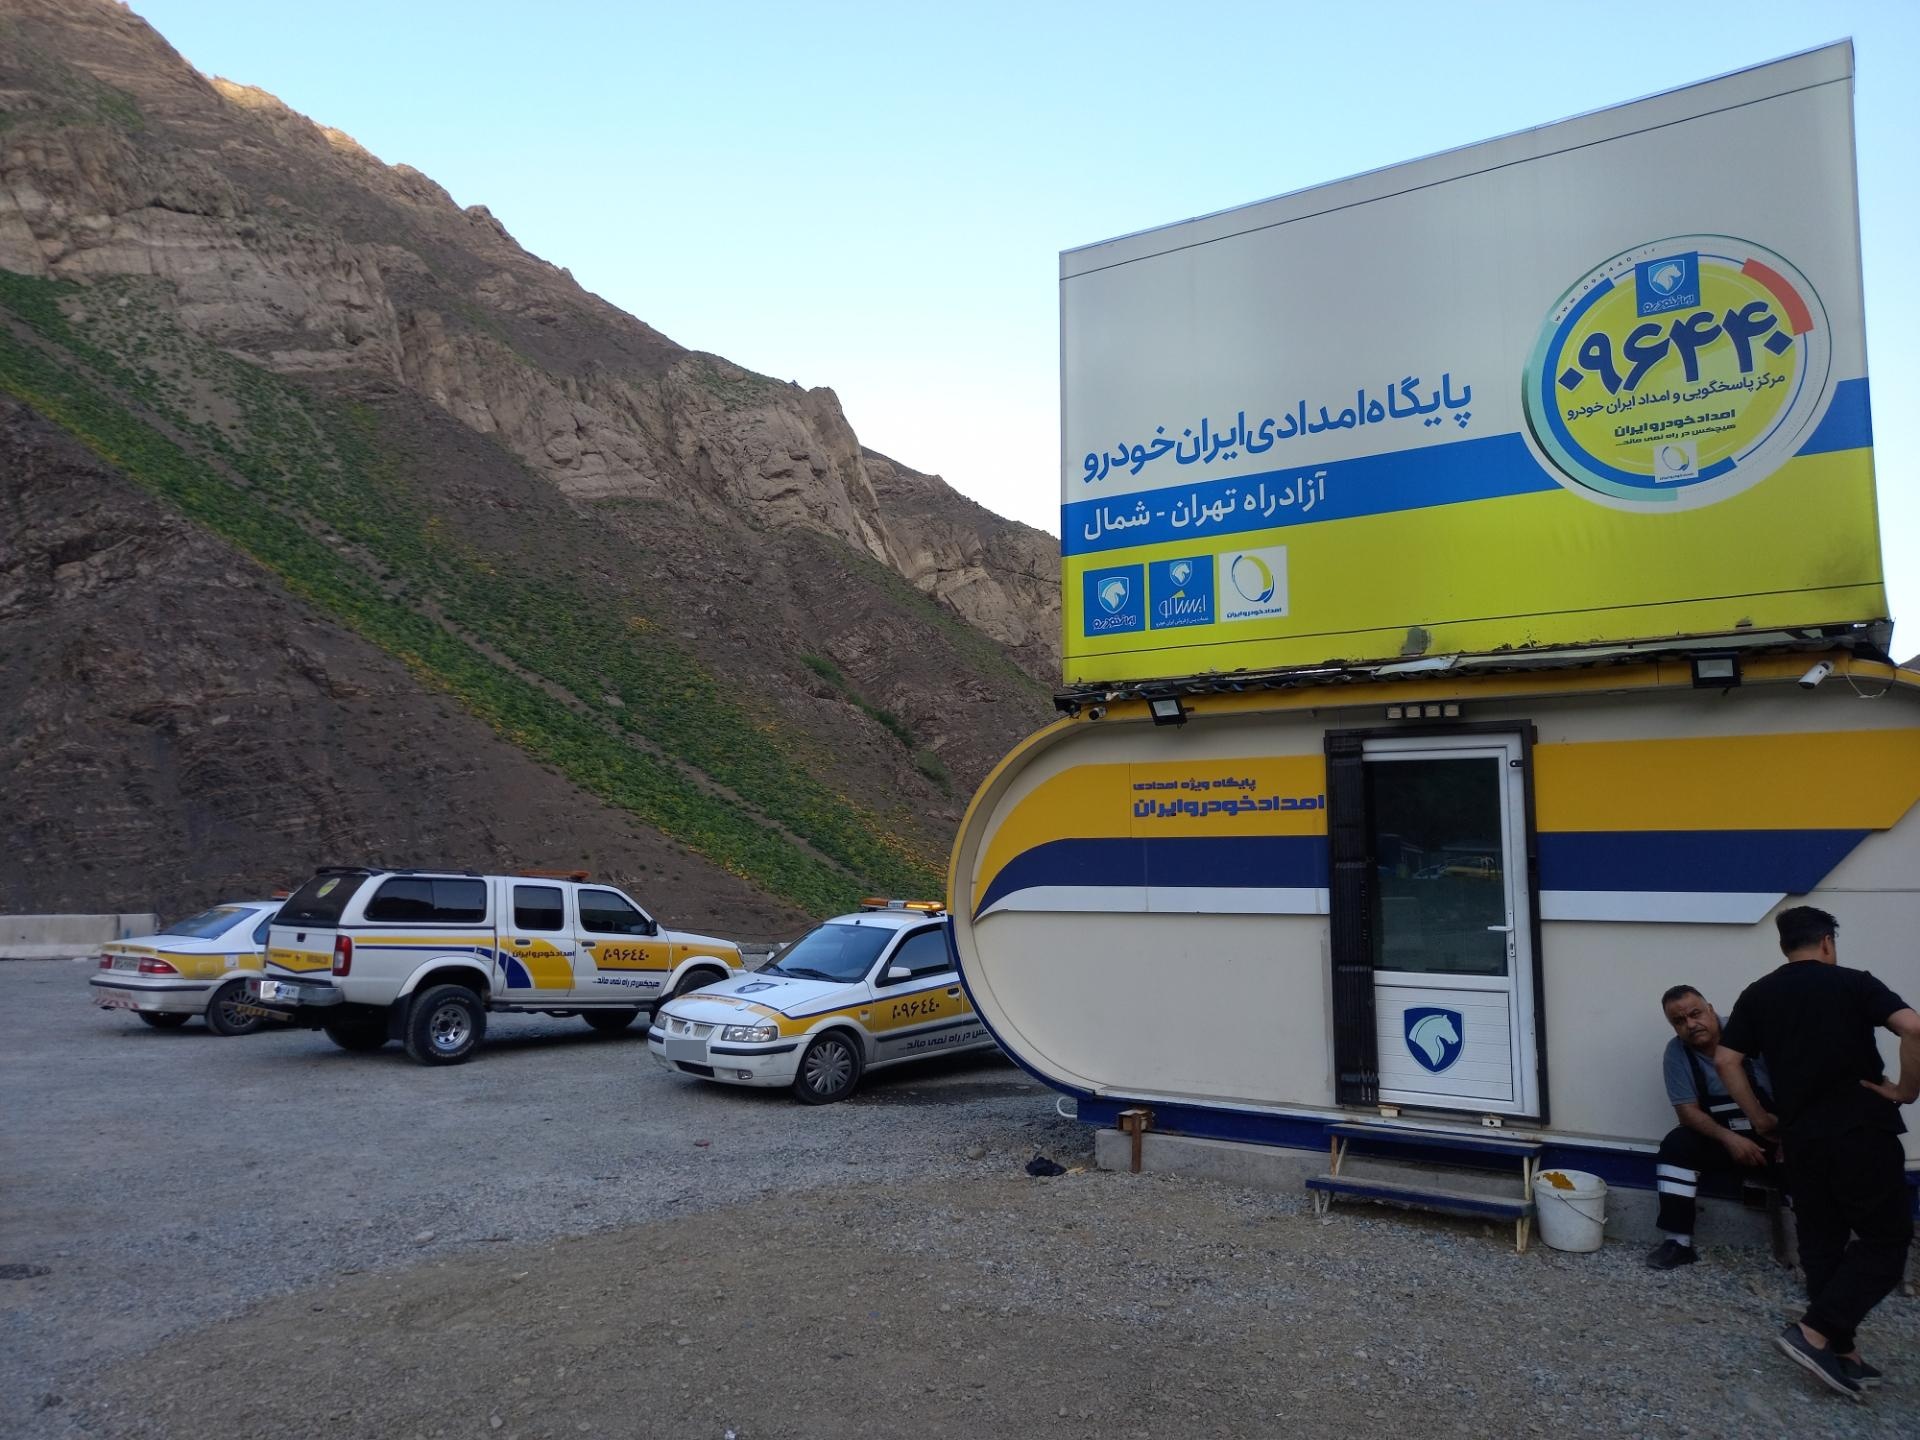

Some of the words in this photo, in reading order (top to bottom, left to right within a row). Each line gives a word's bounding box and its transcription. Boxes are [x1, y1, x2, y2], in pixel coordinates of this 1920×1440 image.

[1558, 301, 1793, 395] ۰۹۶۴۴۰
[1683, 376, 1753, 401] پاسخگویی
[1756, 372, 1785, 391] مرکز
[1367, 373, 1471, 428] پایگاه
[1606, 396, 1636, 414] ایران
[1639, 390, 1670, 406] امداد
[1673, 393, 1680, 403] و
[1567, 401, 1604, 420] خودرو
[1247, 389, 1368, 454] امدادی
[1176, 412, 1246, 465] ایران
[1665, 431, 1679, 439] راه
[1680, 430, 1690, 438] در
[1084, 426, 1175, 483] خودرو
[1171, 489, 1236, 528] تهران
[1084, 501, 1150, 540] شمال
[1133, 780, 1178, 790] امدادی
[1181, 778, 1210, 791] ویژه
[1212, 777, 1256, 791] پایگاه
